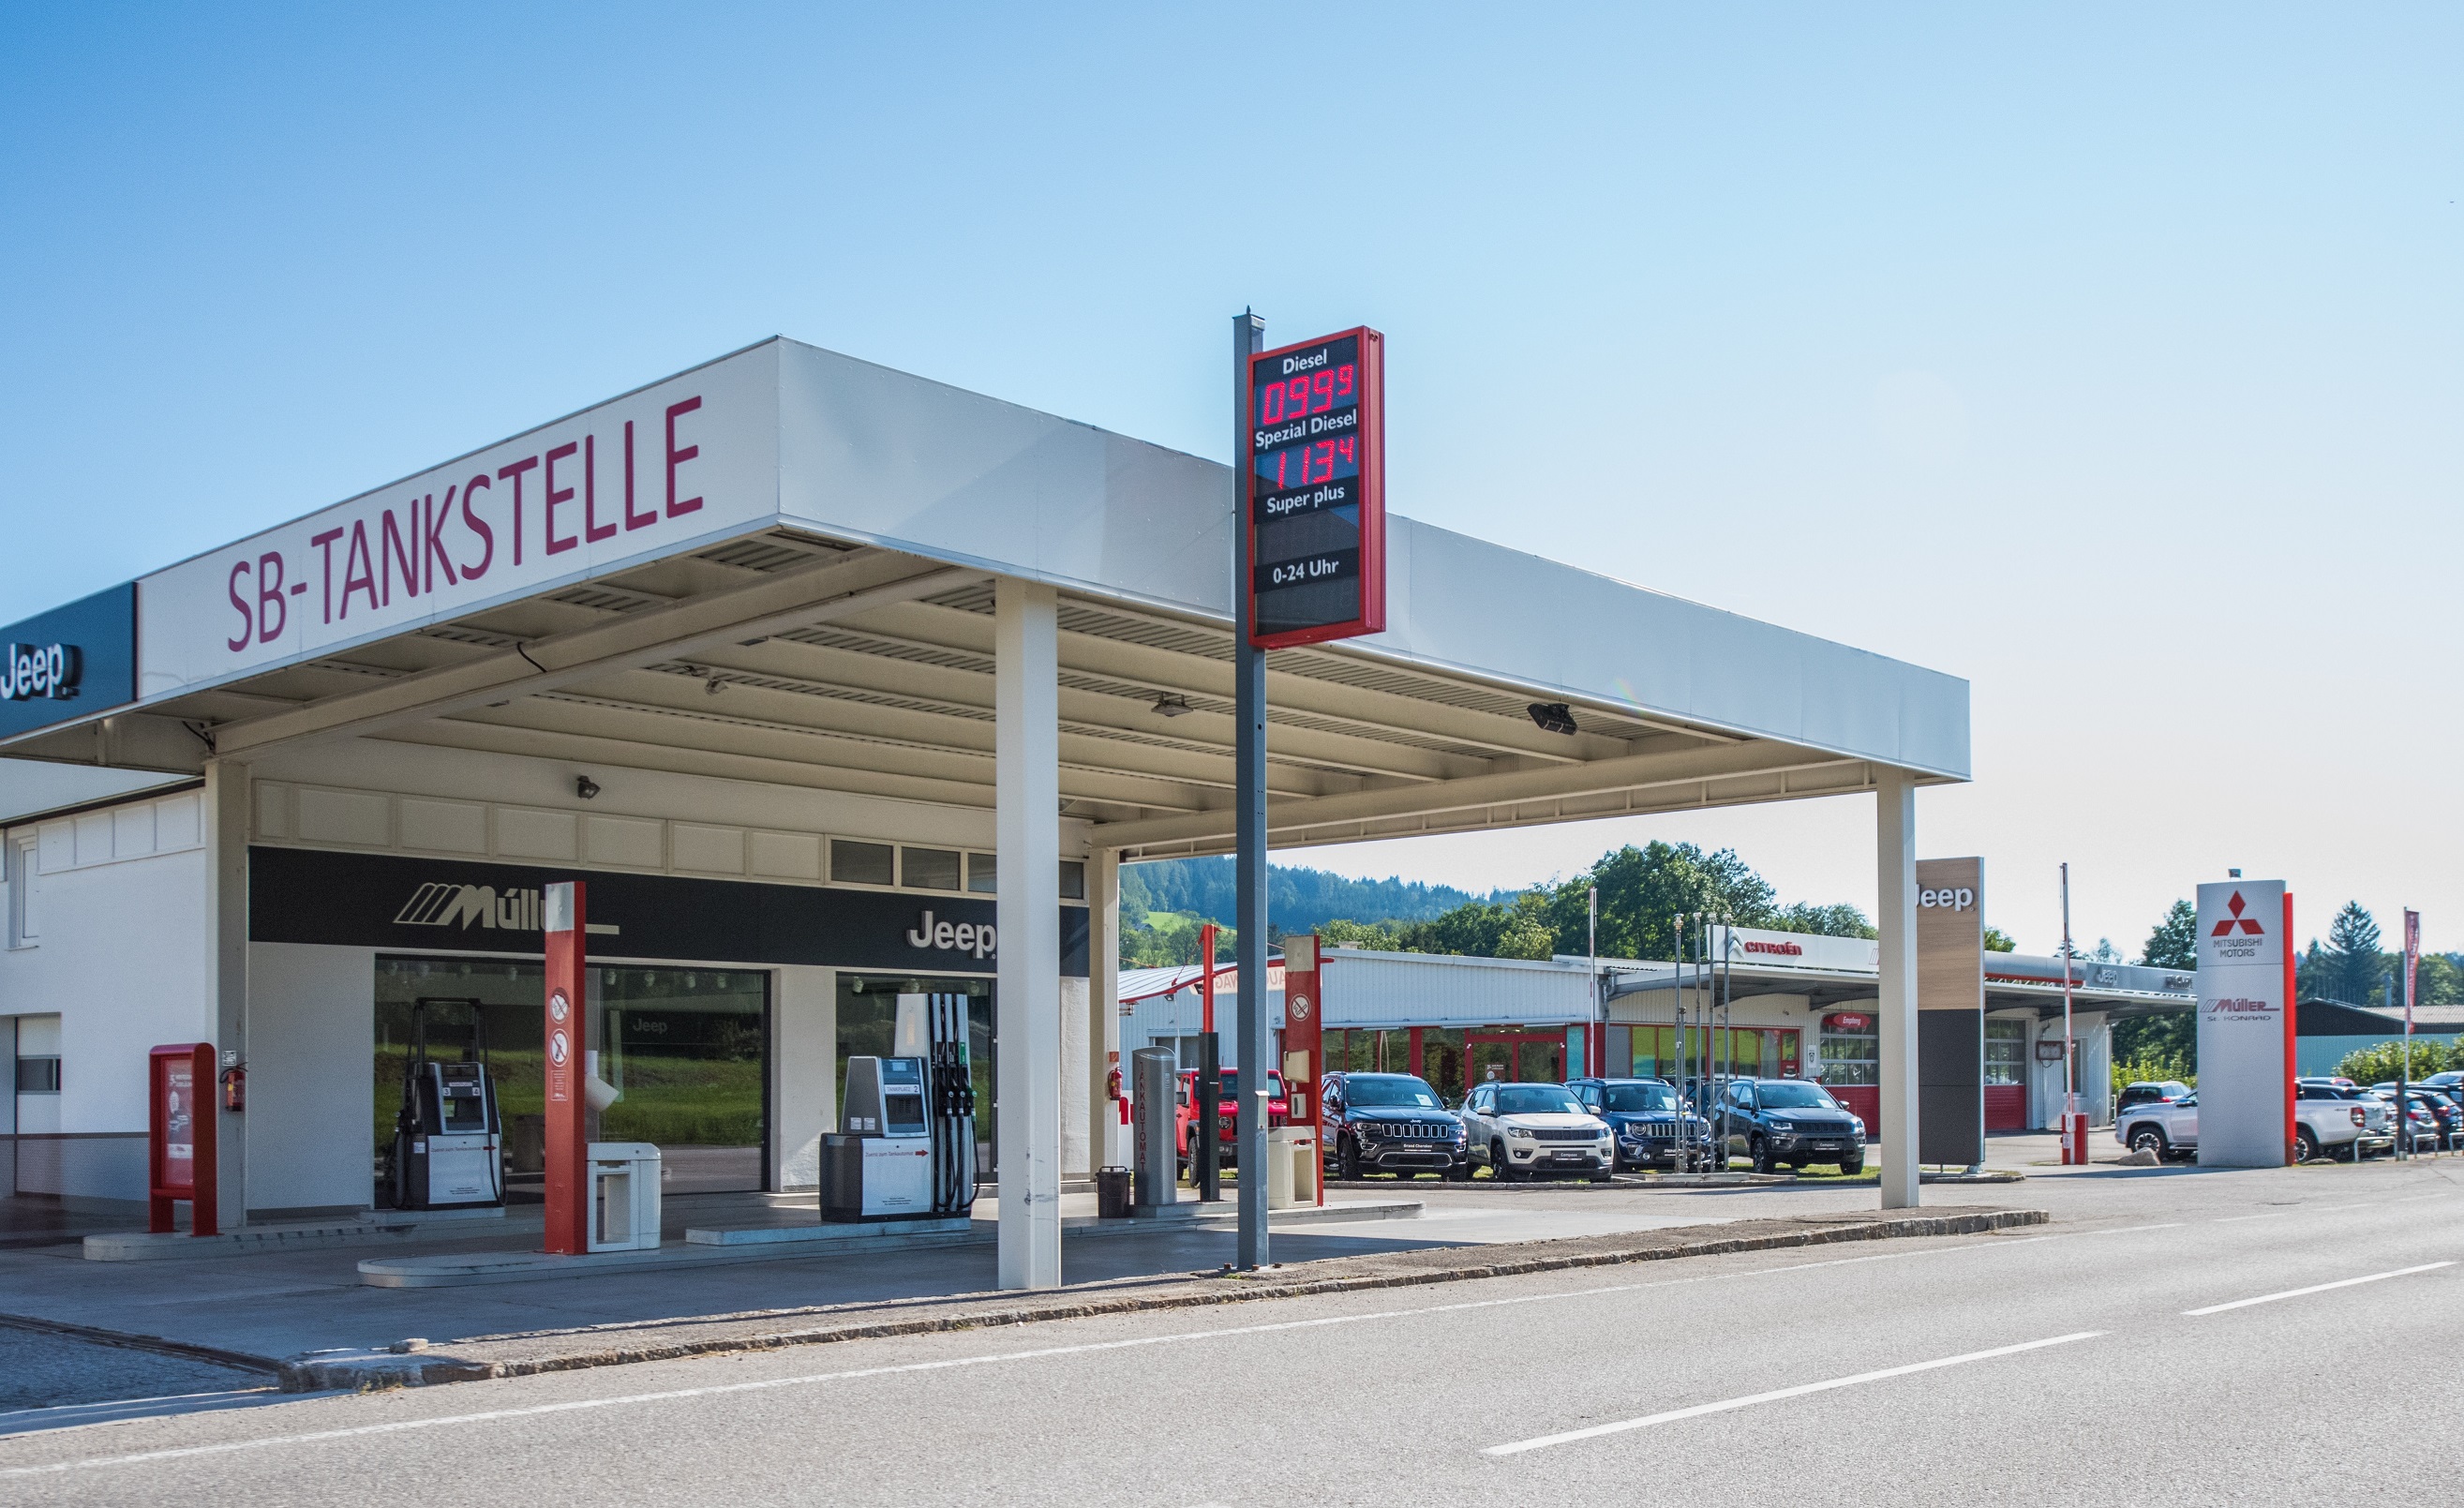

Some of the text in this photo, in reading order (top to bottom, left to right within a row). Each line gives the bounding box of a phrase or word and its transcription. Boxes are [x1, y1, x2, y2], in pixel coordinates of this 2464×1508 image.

[1283, 349, 1327, 375] Diesel
[1255, 409, 1357, 450] Spezial Diesel
[1267, 486, 1345, 515] Super plus
[227, 395, 703, 652] SB-TANKSTELLE
[1273, 559, 1339, 584] 0-24 Uhr
[0, 643, 65, 699] Jeep
[1916, 884, 1974, 912] eep
[906, 910, 996, 959] Jeep
[2213, 938, 2262, 948] MITSUBISHI
[2219, 948, 2255, 958] MOTORS
[632, 1018, 668, 1034] Jeep
